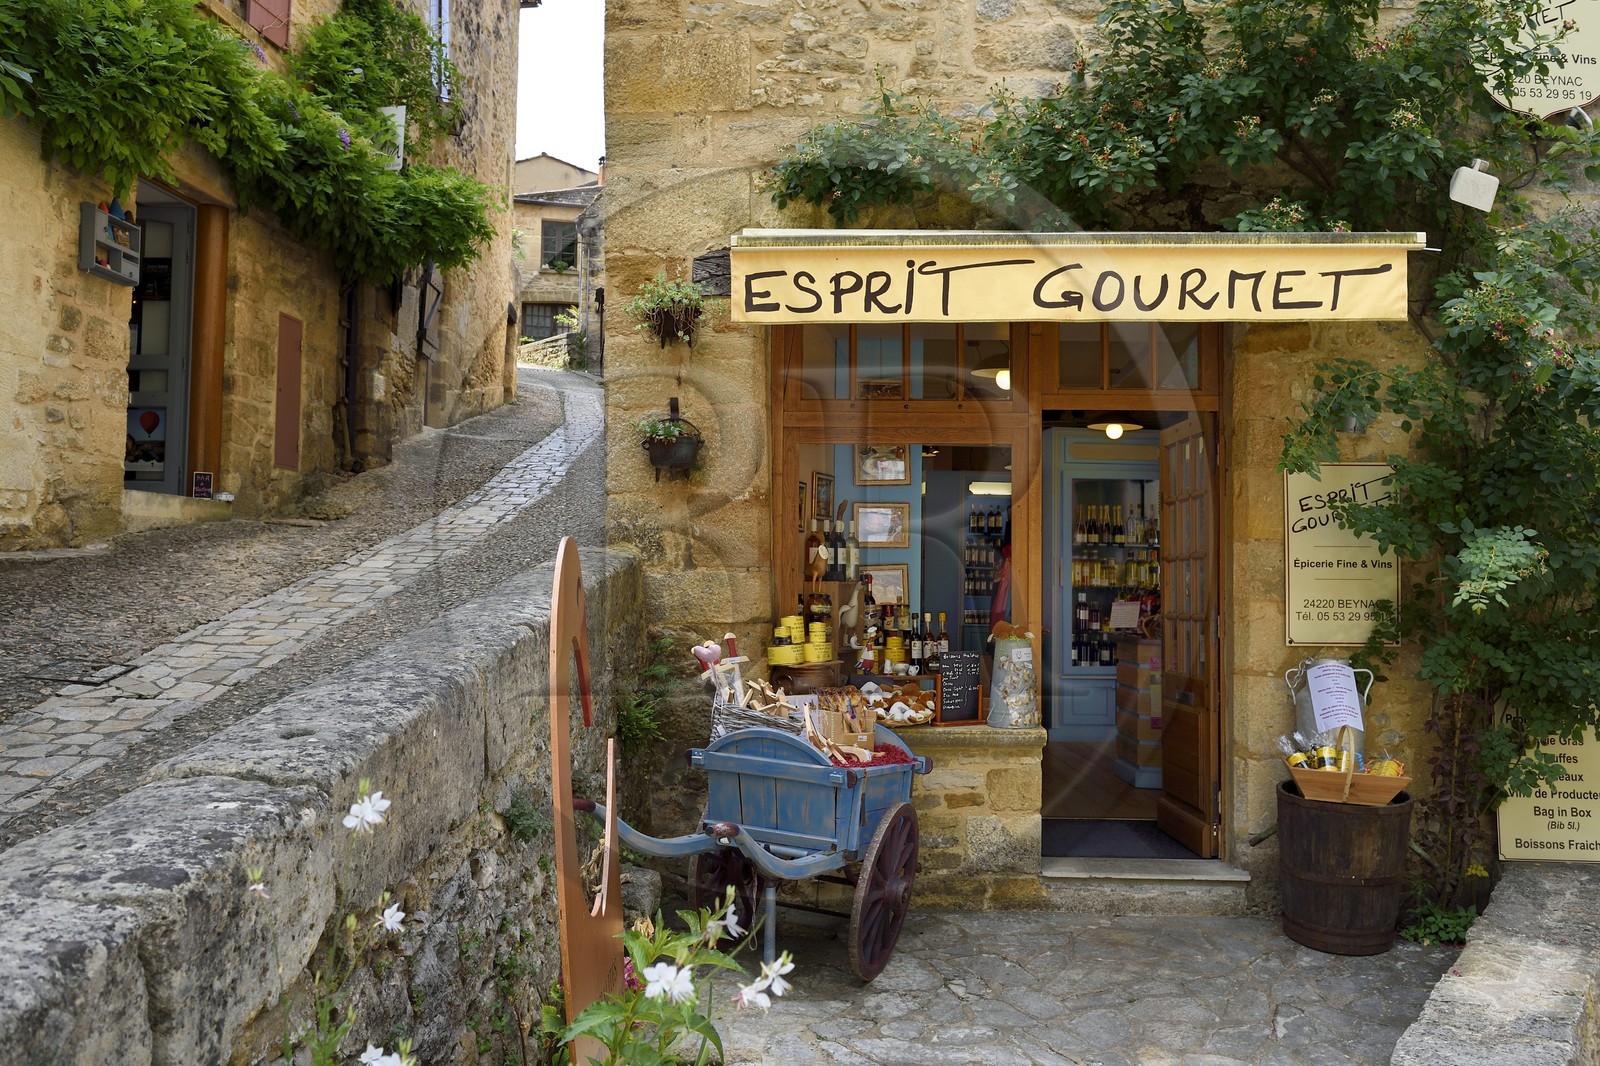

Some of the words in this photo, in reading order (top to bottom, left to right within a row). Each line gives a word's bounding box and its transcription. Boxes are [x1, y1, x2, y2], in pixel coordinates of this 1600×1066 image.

[1561, 53, 1568, 63] &
[1571, 54, 1597, 65] Vins
[1534, 74, 1583, 87] BEYNAC
[1530, 88, 1543, 98] 53
[1546, 88, 1559, 99] 29
[1562, 89, 1576, 100] 95
[1580, 90, 1592, 101] 19
[1033, 263, 1393, 313] GOURMET
[1293, 557, 1334, 570] Épicerie
[1336, 559, 1358, 568] Fine
[1360, 559, 1368, 569] &
[1371, 559, 1393, 569] Vins
[1303, 598, 1335, 609] 24220
[1295, 611, 1314, 621] Tél.
[1317, 611, 1330, 621] 05
[1332, 611, 1346, 621] 53
[1348, 611, 1361, 621] 29
[1534, 788, 1547, 799] de
[1533, 806, 1555, 819] Bag
[1557, 807, 1568, 817] in
[1570, 807, 1592, 818] Box
[1547, 821, 1565, 831] (Bib
[1515, 838, 1565, 850] Boissons
